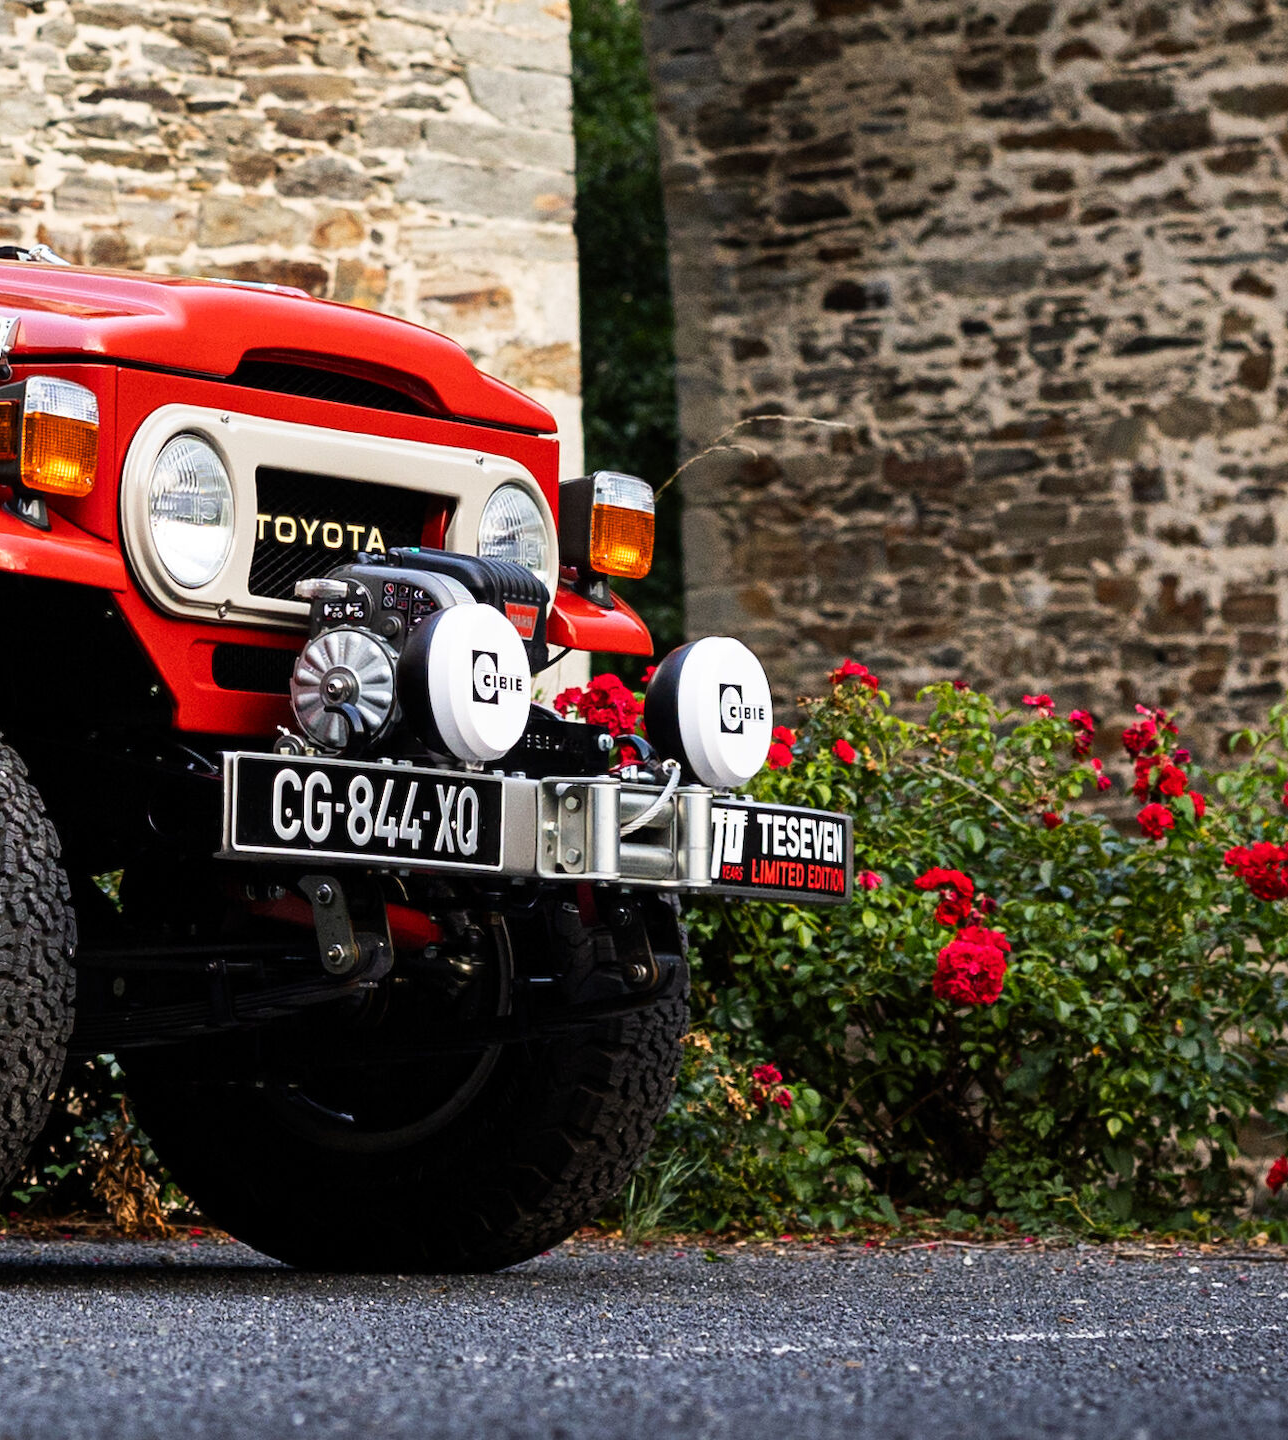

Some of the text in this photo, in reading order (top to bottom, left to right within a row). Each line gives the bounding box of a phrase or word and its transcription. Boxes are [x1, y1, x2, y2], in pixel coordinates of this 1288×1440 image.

[256, 513, 387, 554] TOYOTA
[272, 768, 479, 856] CG-844-XQ
[756, 813, 843, 863] TESEVEN
[751, 858, 845, 894] LIMITED EDITION
